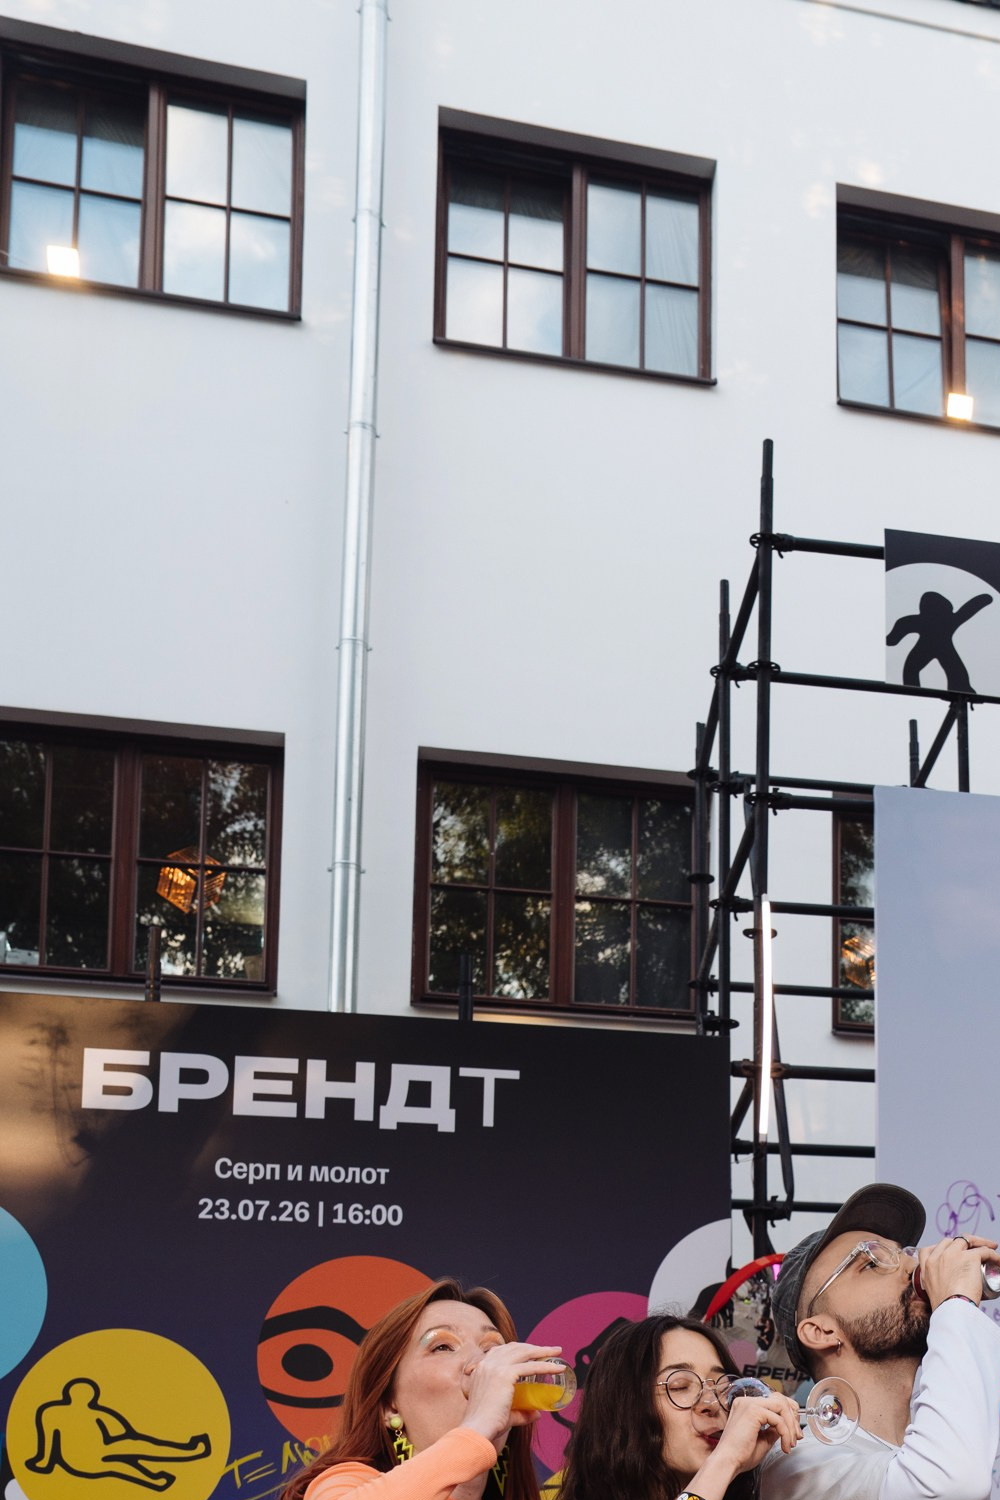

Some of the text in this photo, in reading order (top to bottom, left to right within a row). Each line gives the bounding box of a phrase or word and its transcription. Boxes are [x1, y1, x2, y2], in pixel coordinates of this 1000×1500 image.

[81, 1046, 520, 1133] БРЕНДТ
[214, 1157, 390, 1185] Серп и молот
[198, 1198, 310, 1223] 23.07.26
[332, 1203, 403, 1226] 16:00
